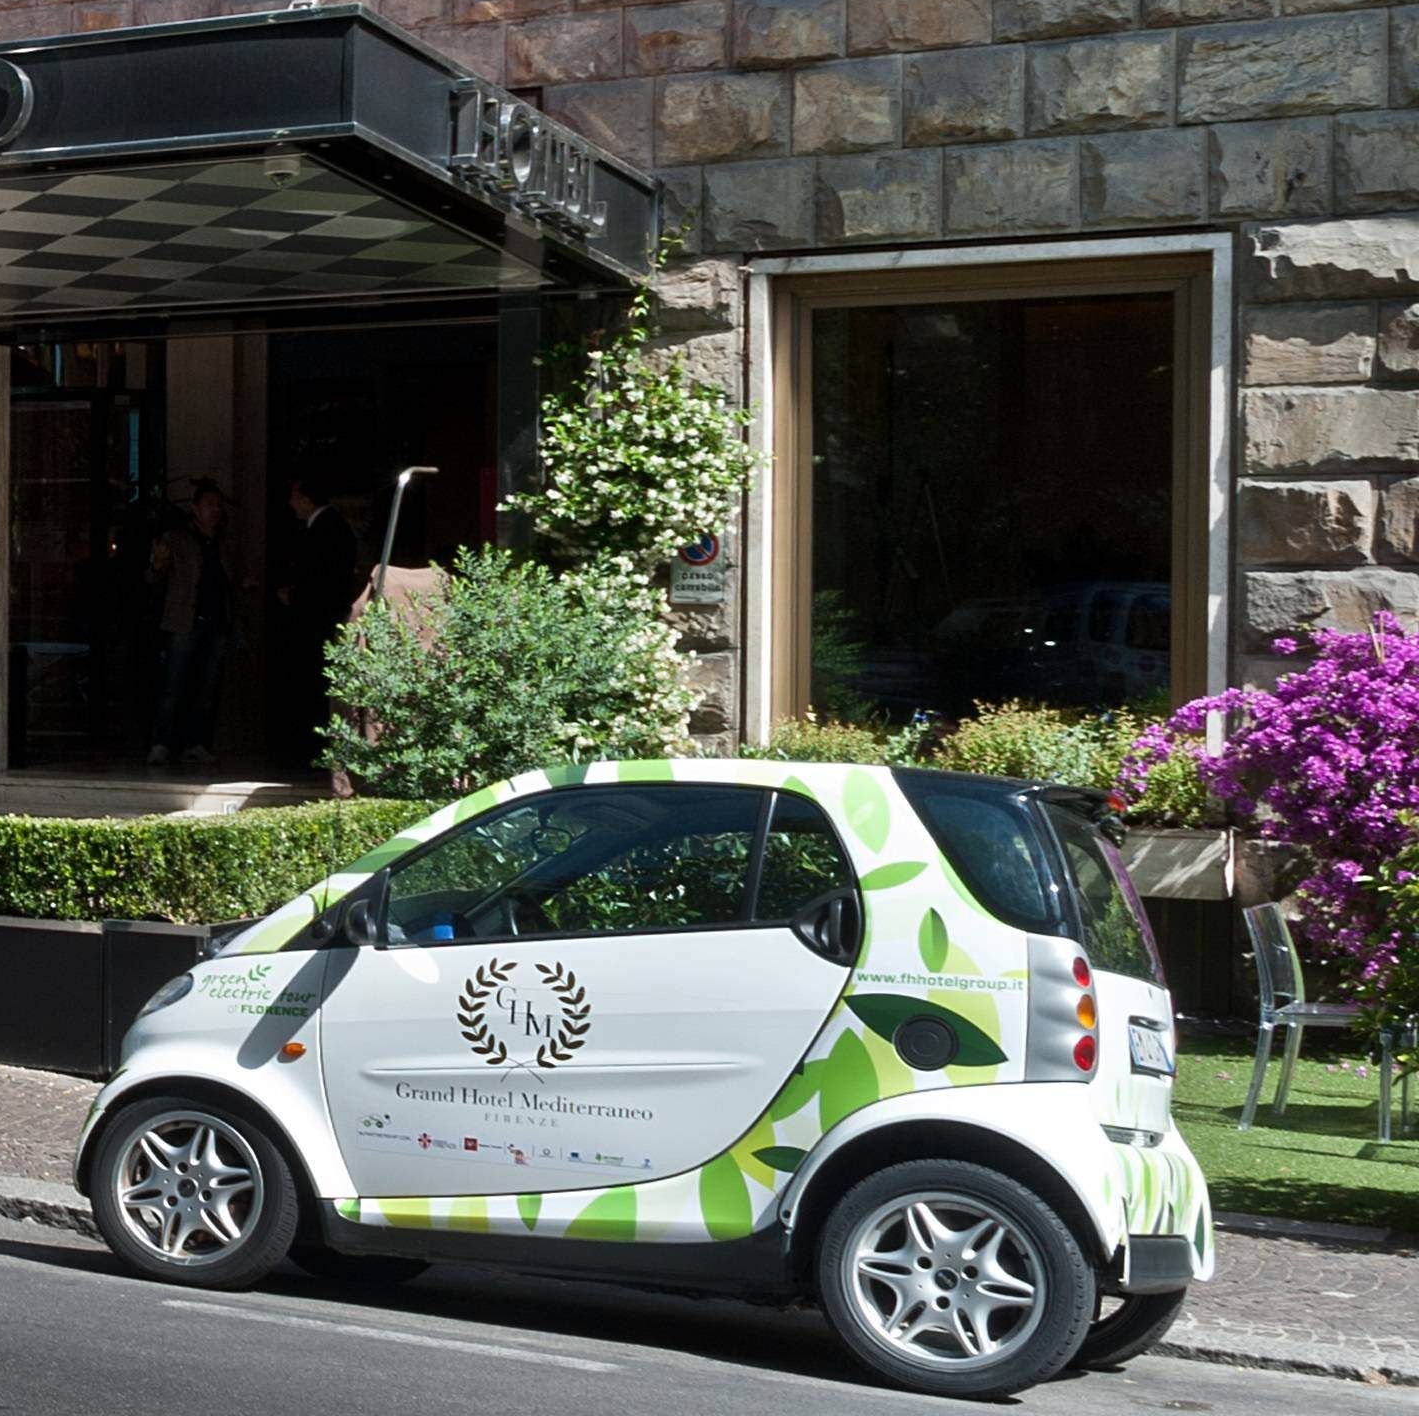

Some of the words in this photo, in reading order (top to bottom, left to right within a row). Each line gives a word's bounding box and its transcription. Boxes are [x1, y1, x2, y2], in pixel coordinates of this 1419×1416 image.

[198, 973, 248, 993] green
[857, 972, 1024, 992] www.fhhotelgroup.it
[208, 983, 272, 1001] electric
[279, 990, 316, 1003] tour
[241, 1004, 309, 1017] FLORENCE
[395, 1081, 455, 1104] Grand
[462, 1087, 514, 1109] Hotel
[520, 1092, 654, 1122] Mediterraneo
[484, 1111, 561, 1129] FIRENZE
